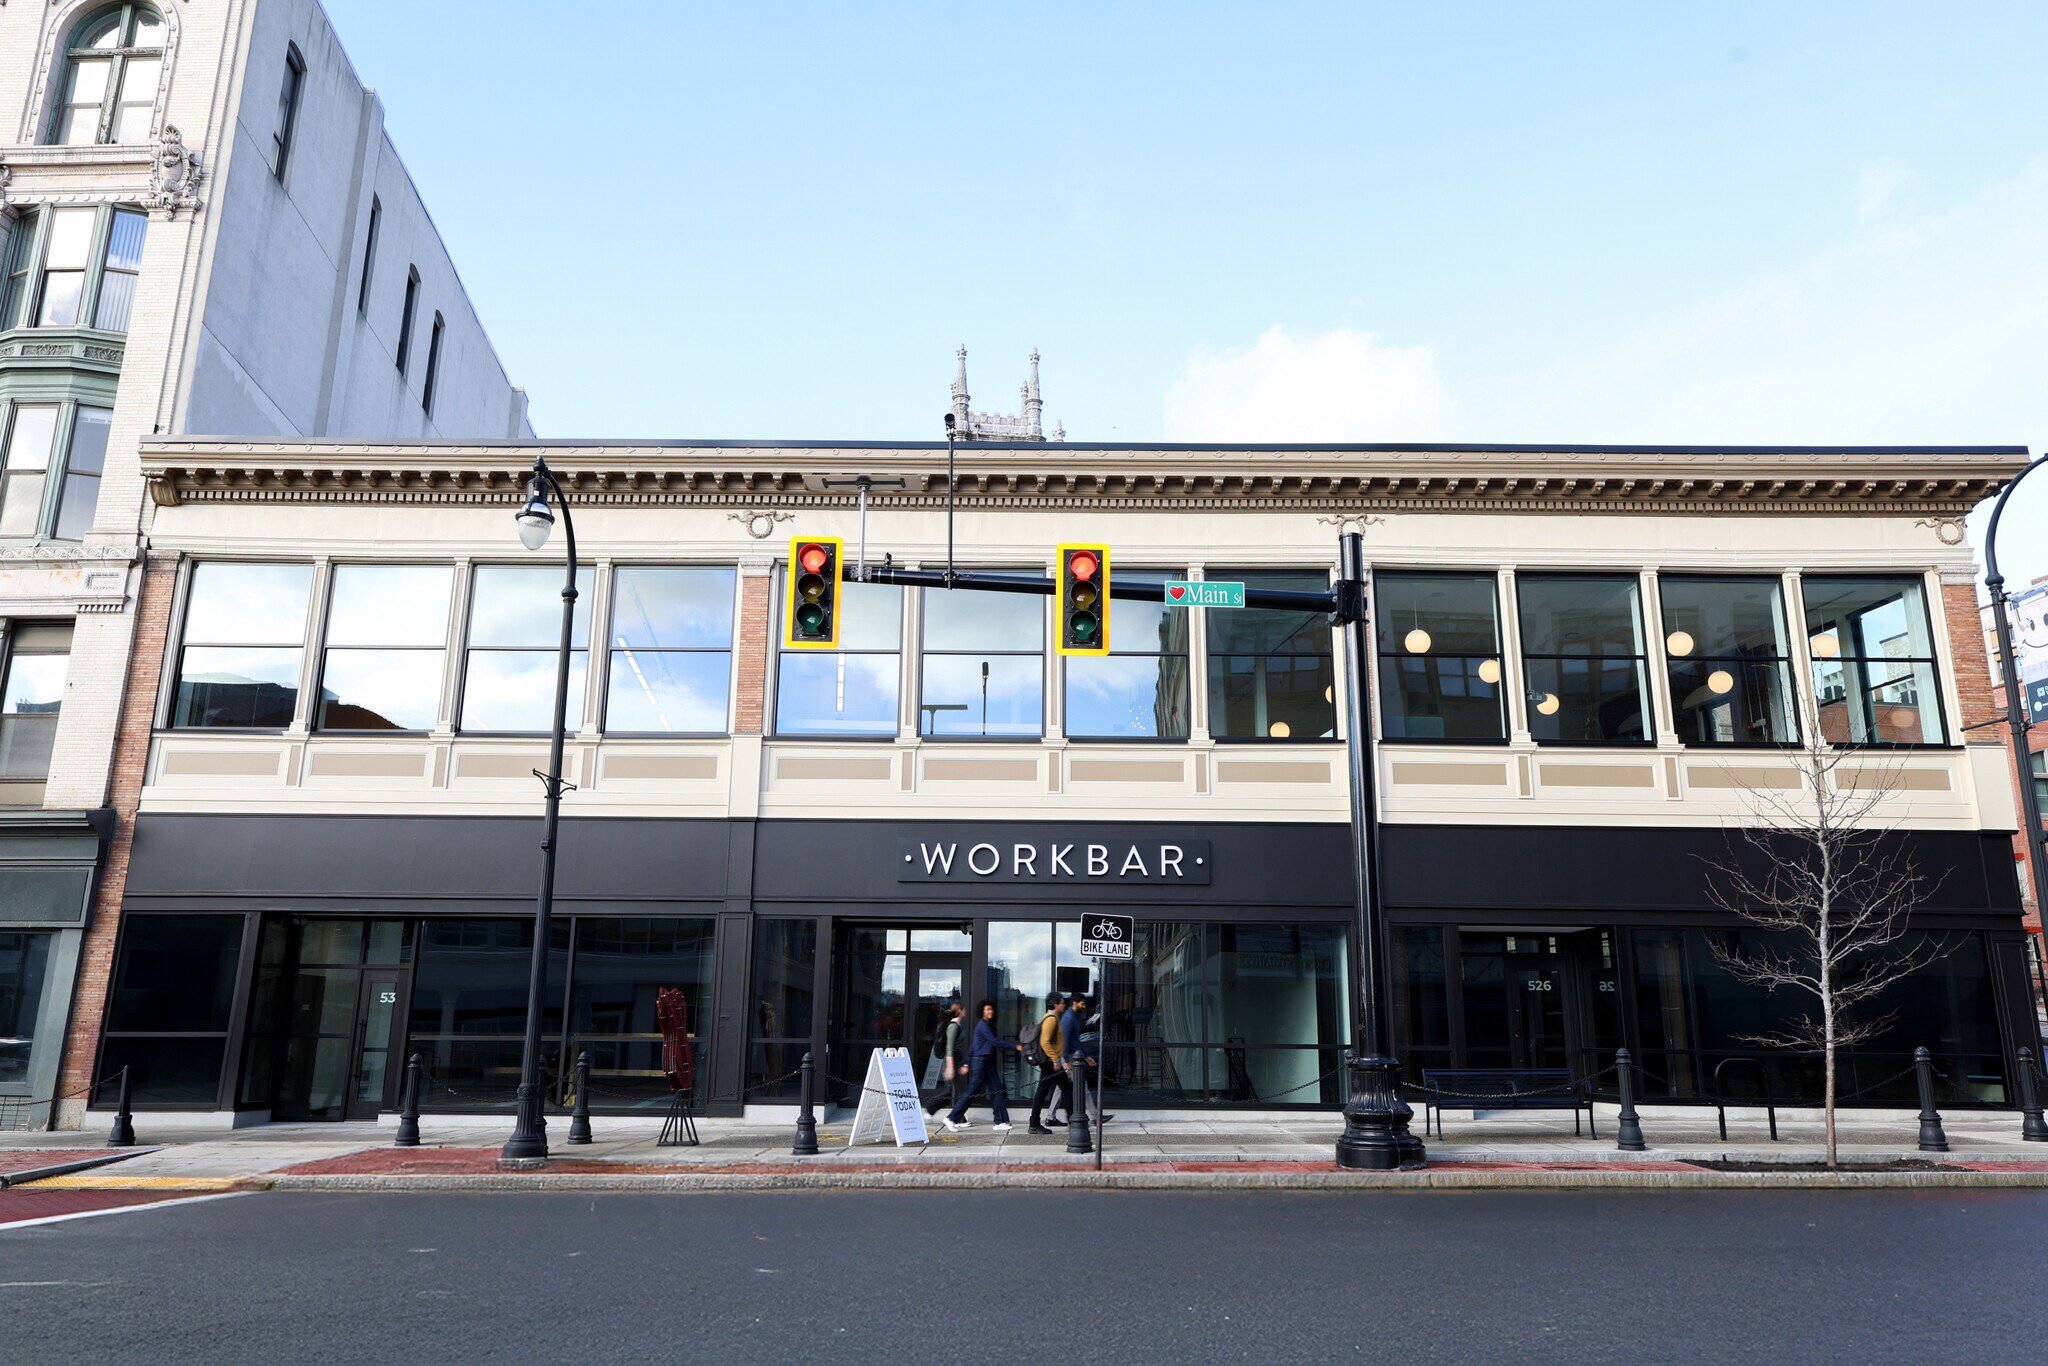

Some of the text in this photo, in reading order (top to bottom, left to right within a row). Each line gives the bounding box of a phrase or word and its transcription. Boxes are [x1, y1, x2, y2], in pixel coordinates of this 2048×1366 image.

[1187, 584, 1242, 604] Main St
[920, 842, 1184, 877] WORKBAR
[1083, 941, 1129, 955] BIKE LANE
[928, 981, 954, 992] 530
[1527, 980, 1552, 991] 526
[379, 992, 396, 1003] 53
[893, 1088, 912, 1099] TOUR
[894, 1100, 916, 1112] TODAY
